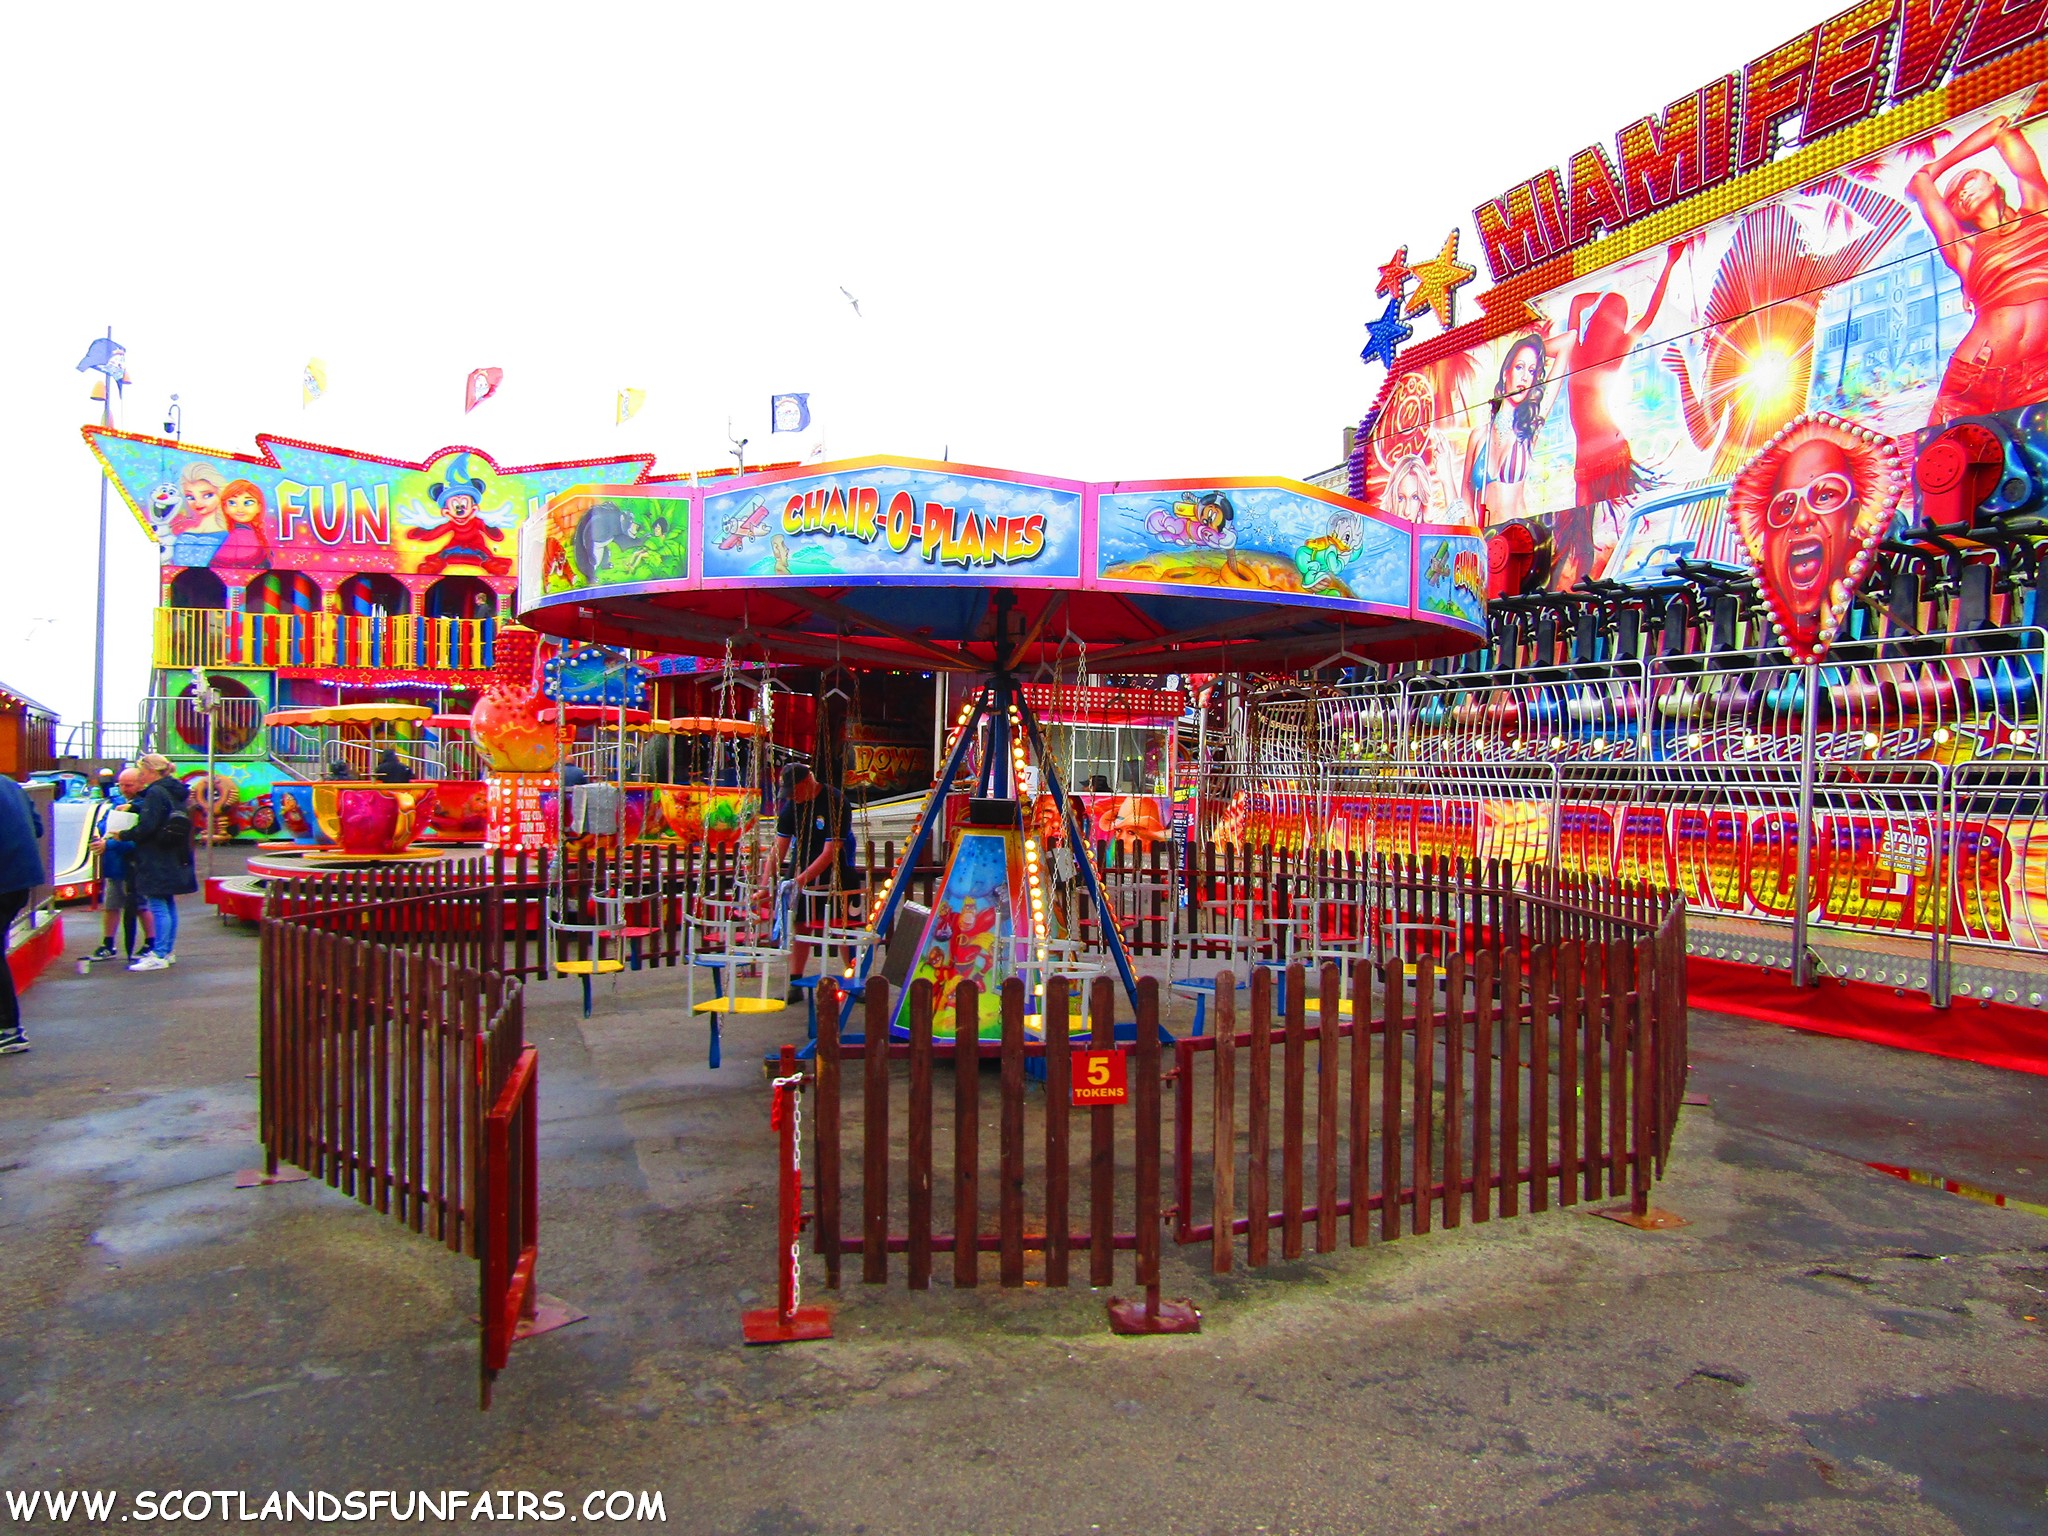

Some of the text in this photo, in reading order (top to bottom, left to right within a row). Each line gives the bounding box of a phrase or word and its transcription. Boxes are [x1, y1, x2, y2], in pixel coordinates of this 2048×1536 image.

[1472, 70, 1740, 283] MIAMI
[275, 478, 391, 546] FUN
[782, 485, 1046, 569] CHAIR-O-PLANES
[520, 822, 546, 833] FROM THE
[1883, 830, 1928, 847] STAND
[1087, 1056, 1110, 1086] 5
[1075, 1087, 1124, 1098] TOKENS
